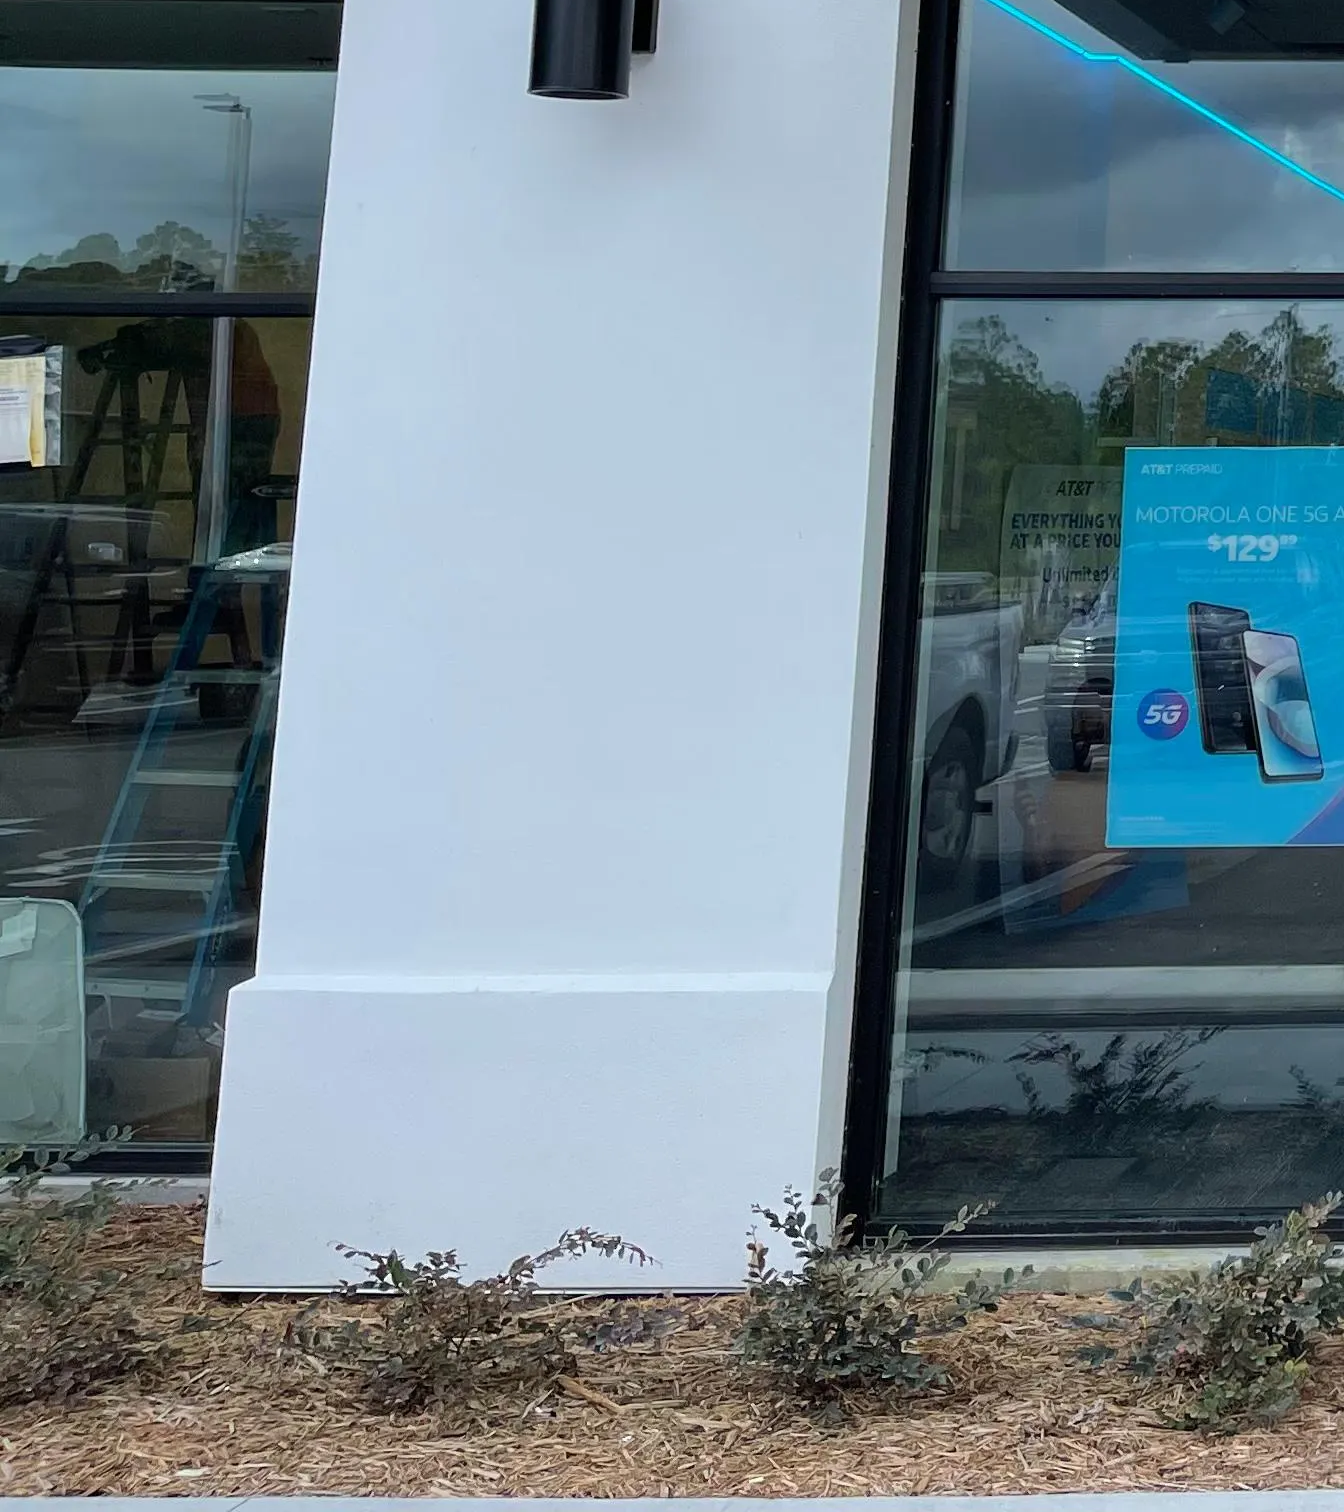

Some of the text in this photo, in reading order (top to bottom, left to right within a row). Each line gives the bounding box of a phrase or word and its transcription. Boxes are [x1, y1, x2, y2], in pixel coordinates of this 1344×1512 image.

[1140, 464, 1174, 475] AT&T
[1056, 480, 1095, 496] AT&T
[1011, 513, 1105, 529] EVERYTHING
[1135, 505, 1251, 523] MOTOROLA
[1256, 505, 1298, 523] ONE
[1303, 505, 1328, 523] 5G
[1010, 533, 1029, 549] AT
[1042, 565, 1109, 583] Unlimited
[1143, 704, 1183, 725] 5G
